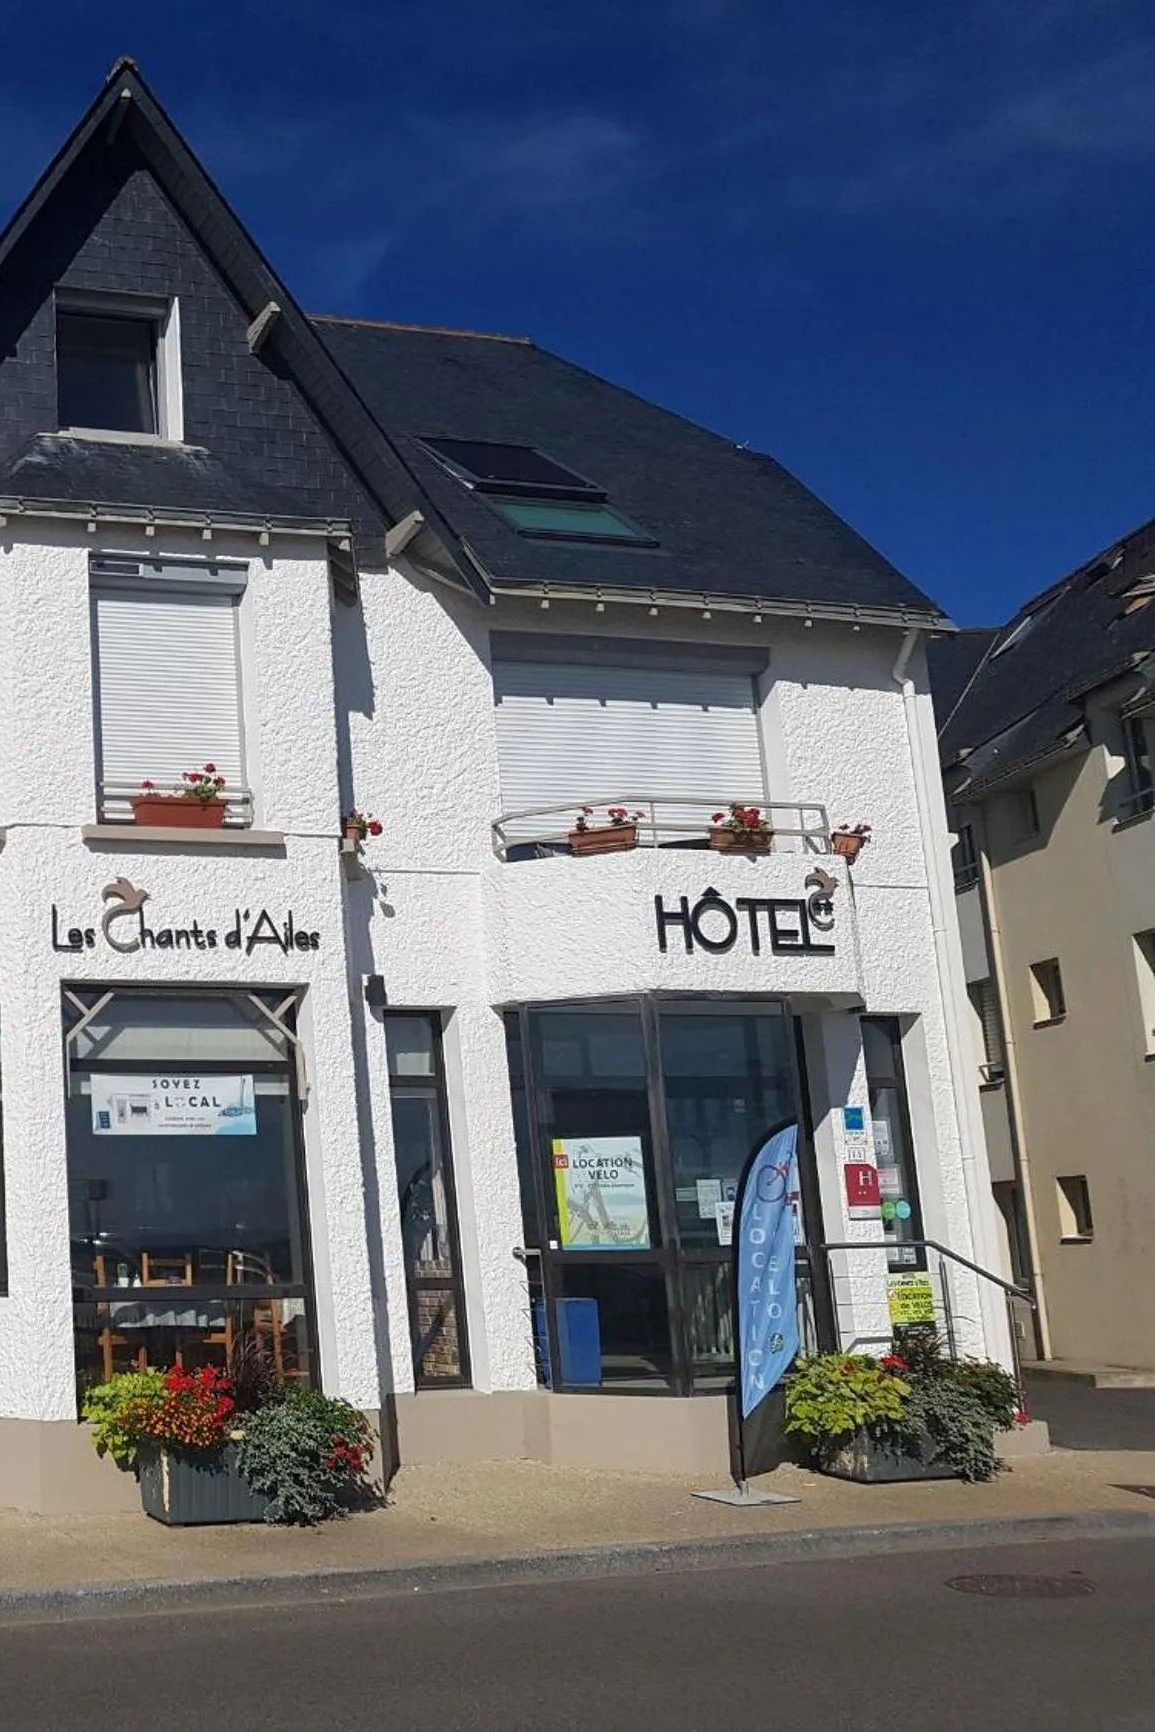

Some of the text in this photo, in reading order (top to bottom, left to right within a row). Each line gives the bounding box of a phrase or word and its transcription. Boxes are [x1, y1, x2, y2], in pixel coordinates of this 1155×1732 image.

[52, 885, 321, 957] Les Chants d'Ailes
[654, 886, 835, 956] HÔTEL
[152, 1079, 201, 1089] SOYEZ
[573, 1157, 633, 1168] LOCATION
[749, 1203, 766, 1390] LOCATION
